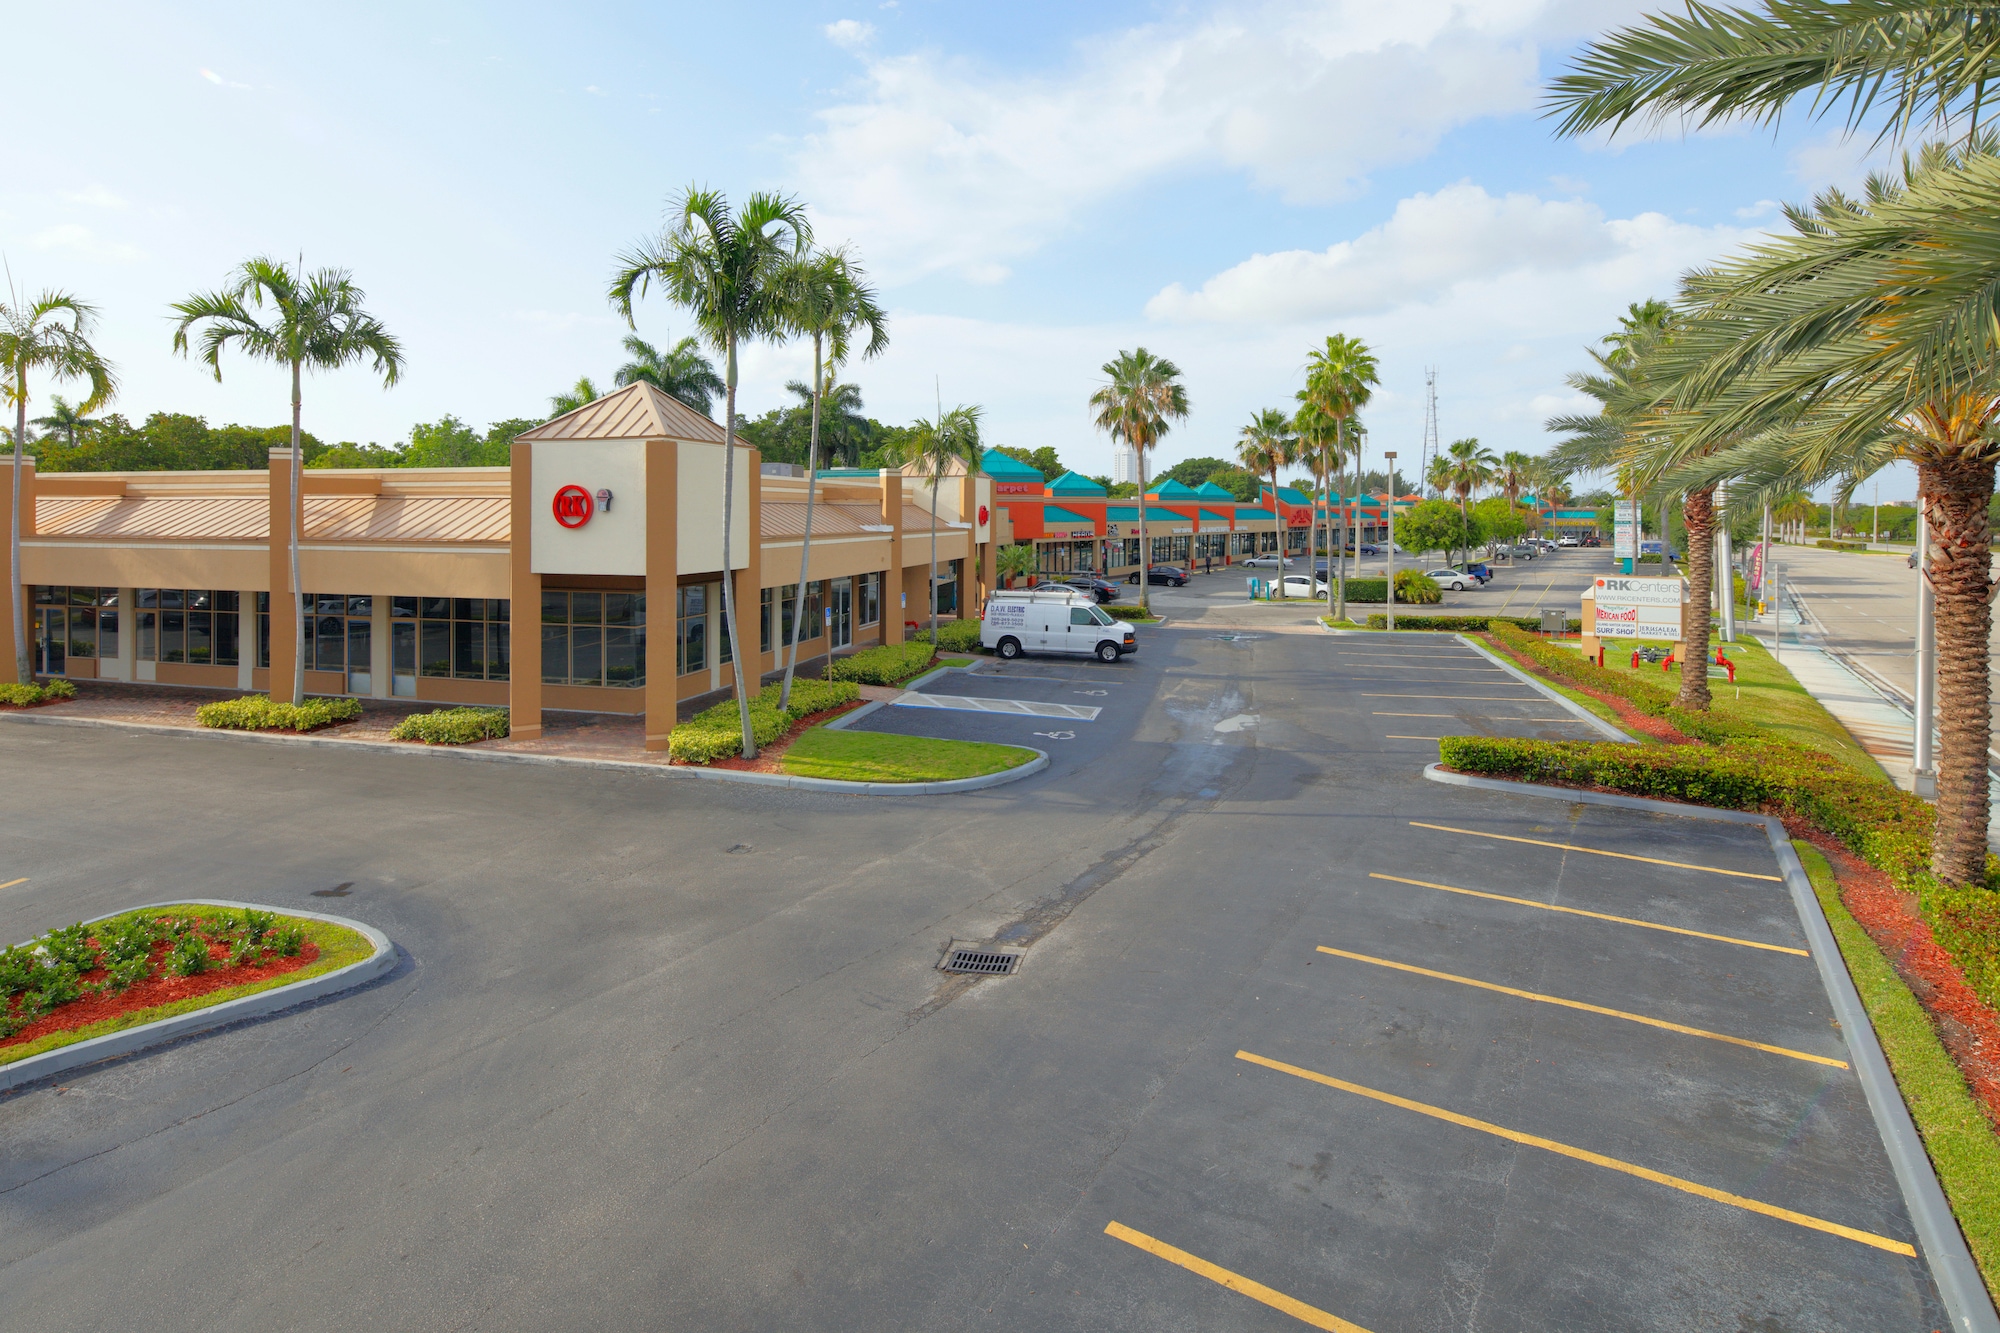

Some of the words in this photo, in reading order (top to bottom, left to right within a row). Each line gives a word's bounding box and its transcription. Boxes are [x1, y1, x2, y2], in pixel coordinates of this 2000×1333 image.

[996, 485, 1028, 494] arpet
[559, 495, 585, 517] RK
[1596, 594, 1680, 604] WWW.RKCENTERS.COM
[1008, 605, 1025, 613] ELECTRIC
[1596, 607, 1620, 620] MEXICAN
[1620, 609, 1636, 621] FOOD
